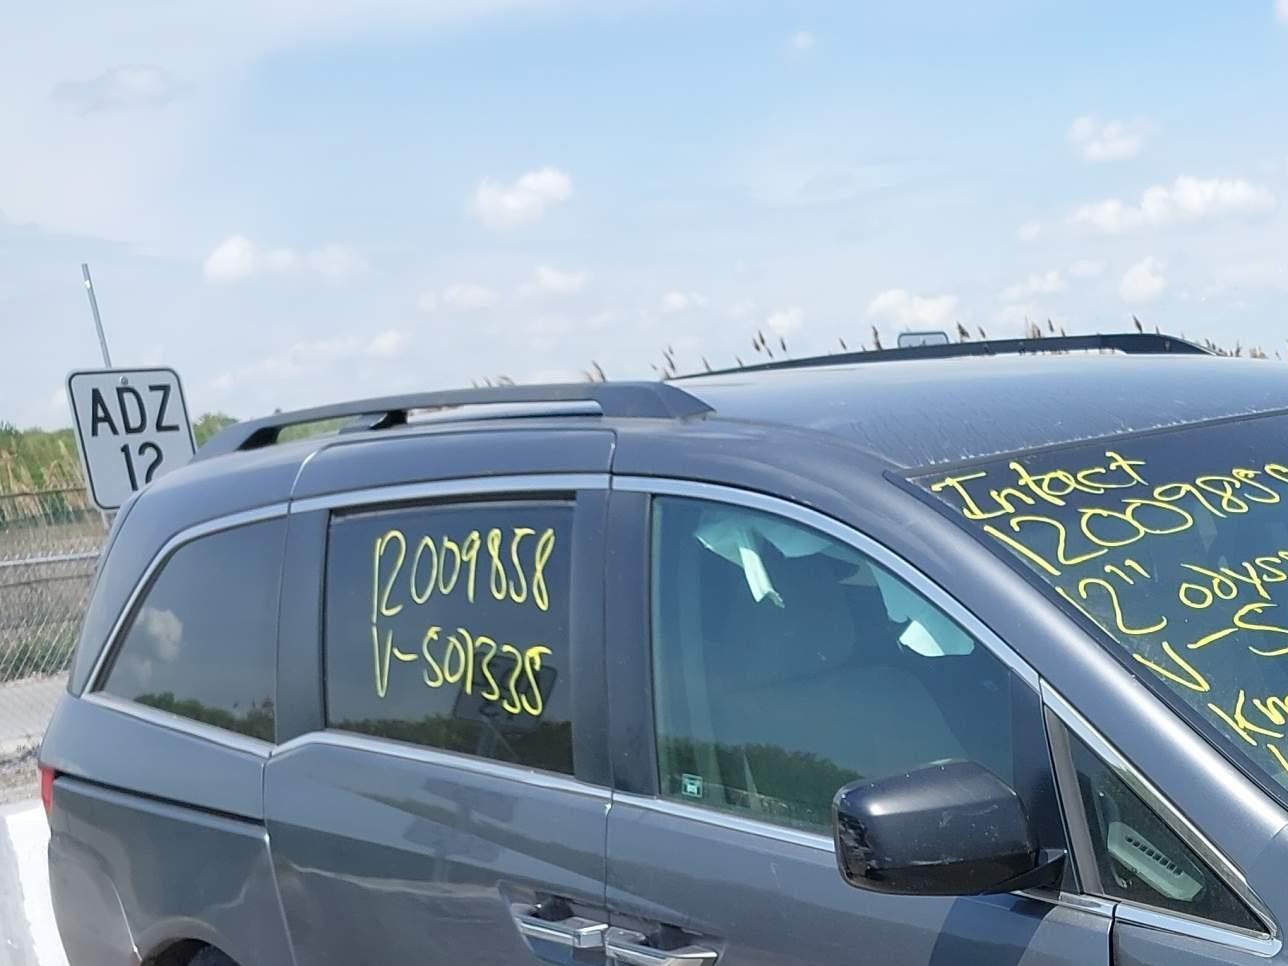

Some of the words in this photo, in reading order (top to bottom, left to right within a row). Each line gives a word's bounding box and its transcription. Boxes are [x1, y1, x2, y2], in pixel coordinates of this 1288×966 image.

[91, 384, 180, 437] ADZ
[931, 451, 1148, 520] Intact
[372, 527, 556, 624] 12009858
